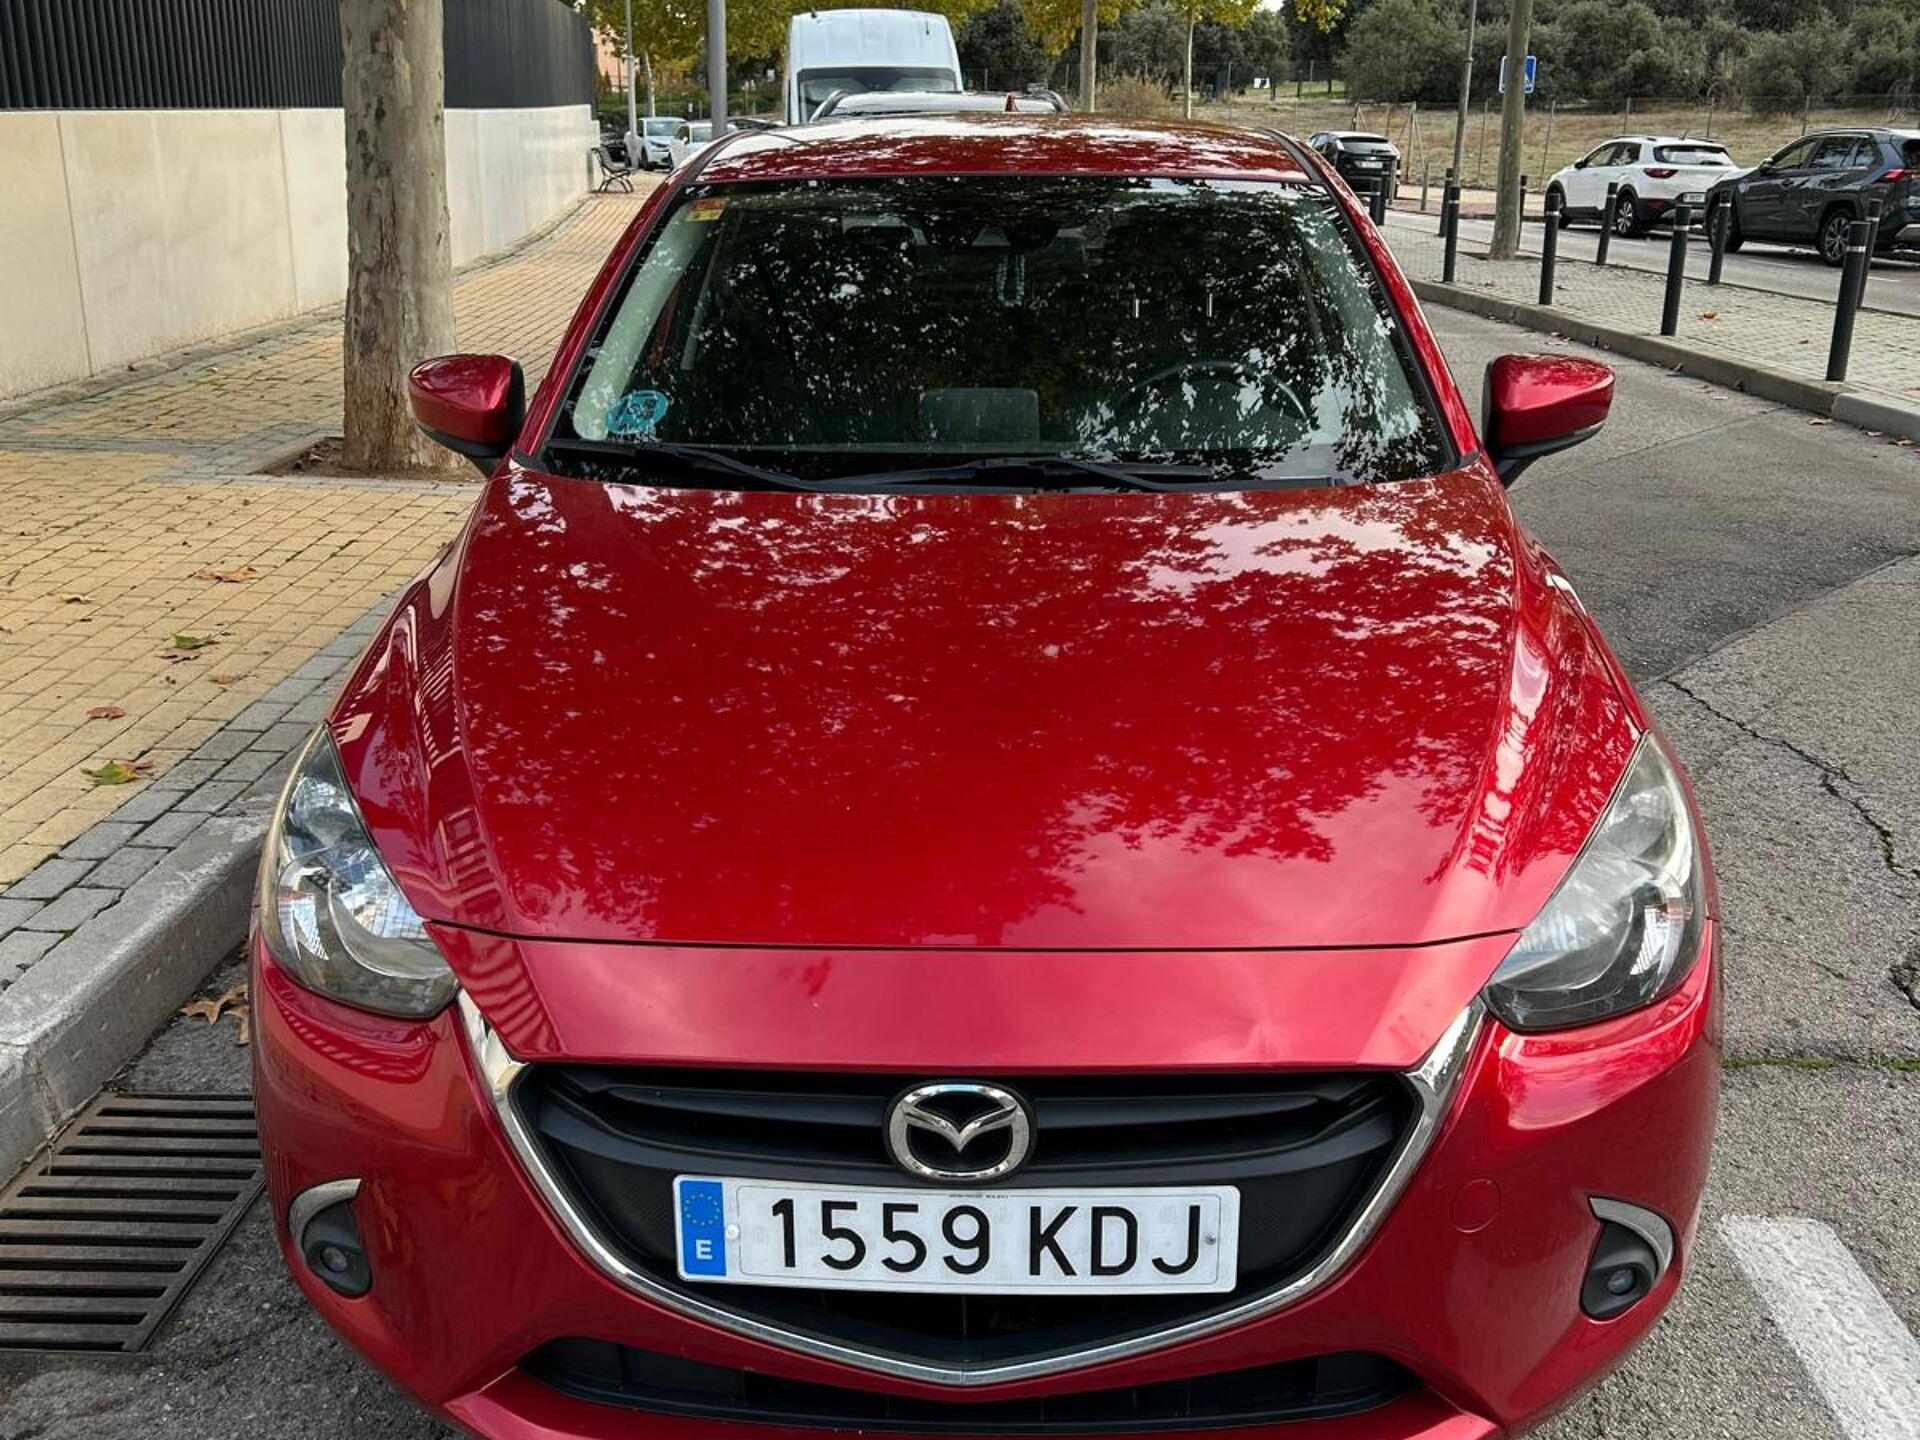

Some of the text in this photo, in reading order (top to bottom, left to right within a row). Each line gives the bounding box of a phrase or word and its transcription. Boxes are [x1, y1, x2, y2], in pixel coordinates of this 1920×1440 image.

[696, 1239, 713, 1259] E
[771, 1198, 1201, 1276] 1559 KDJ
